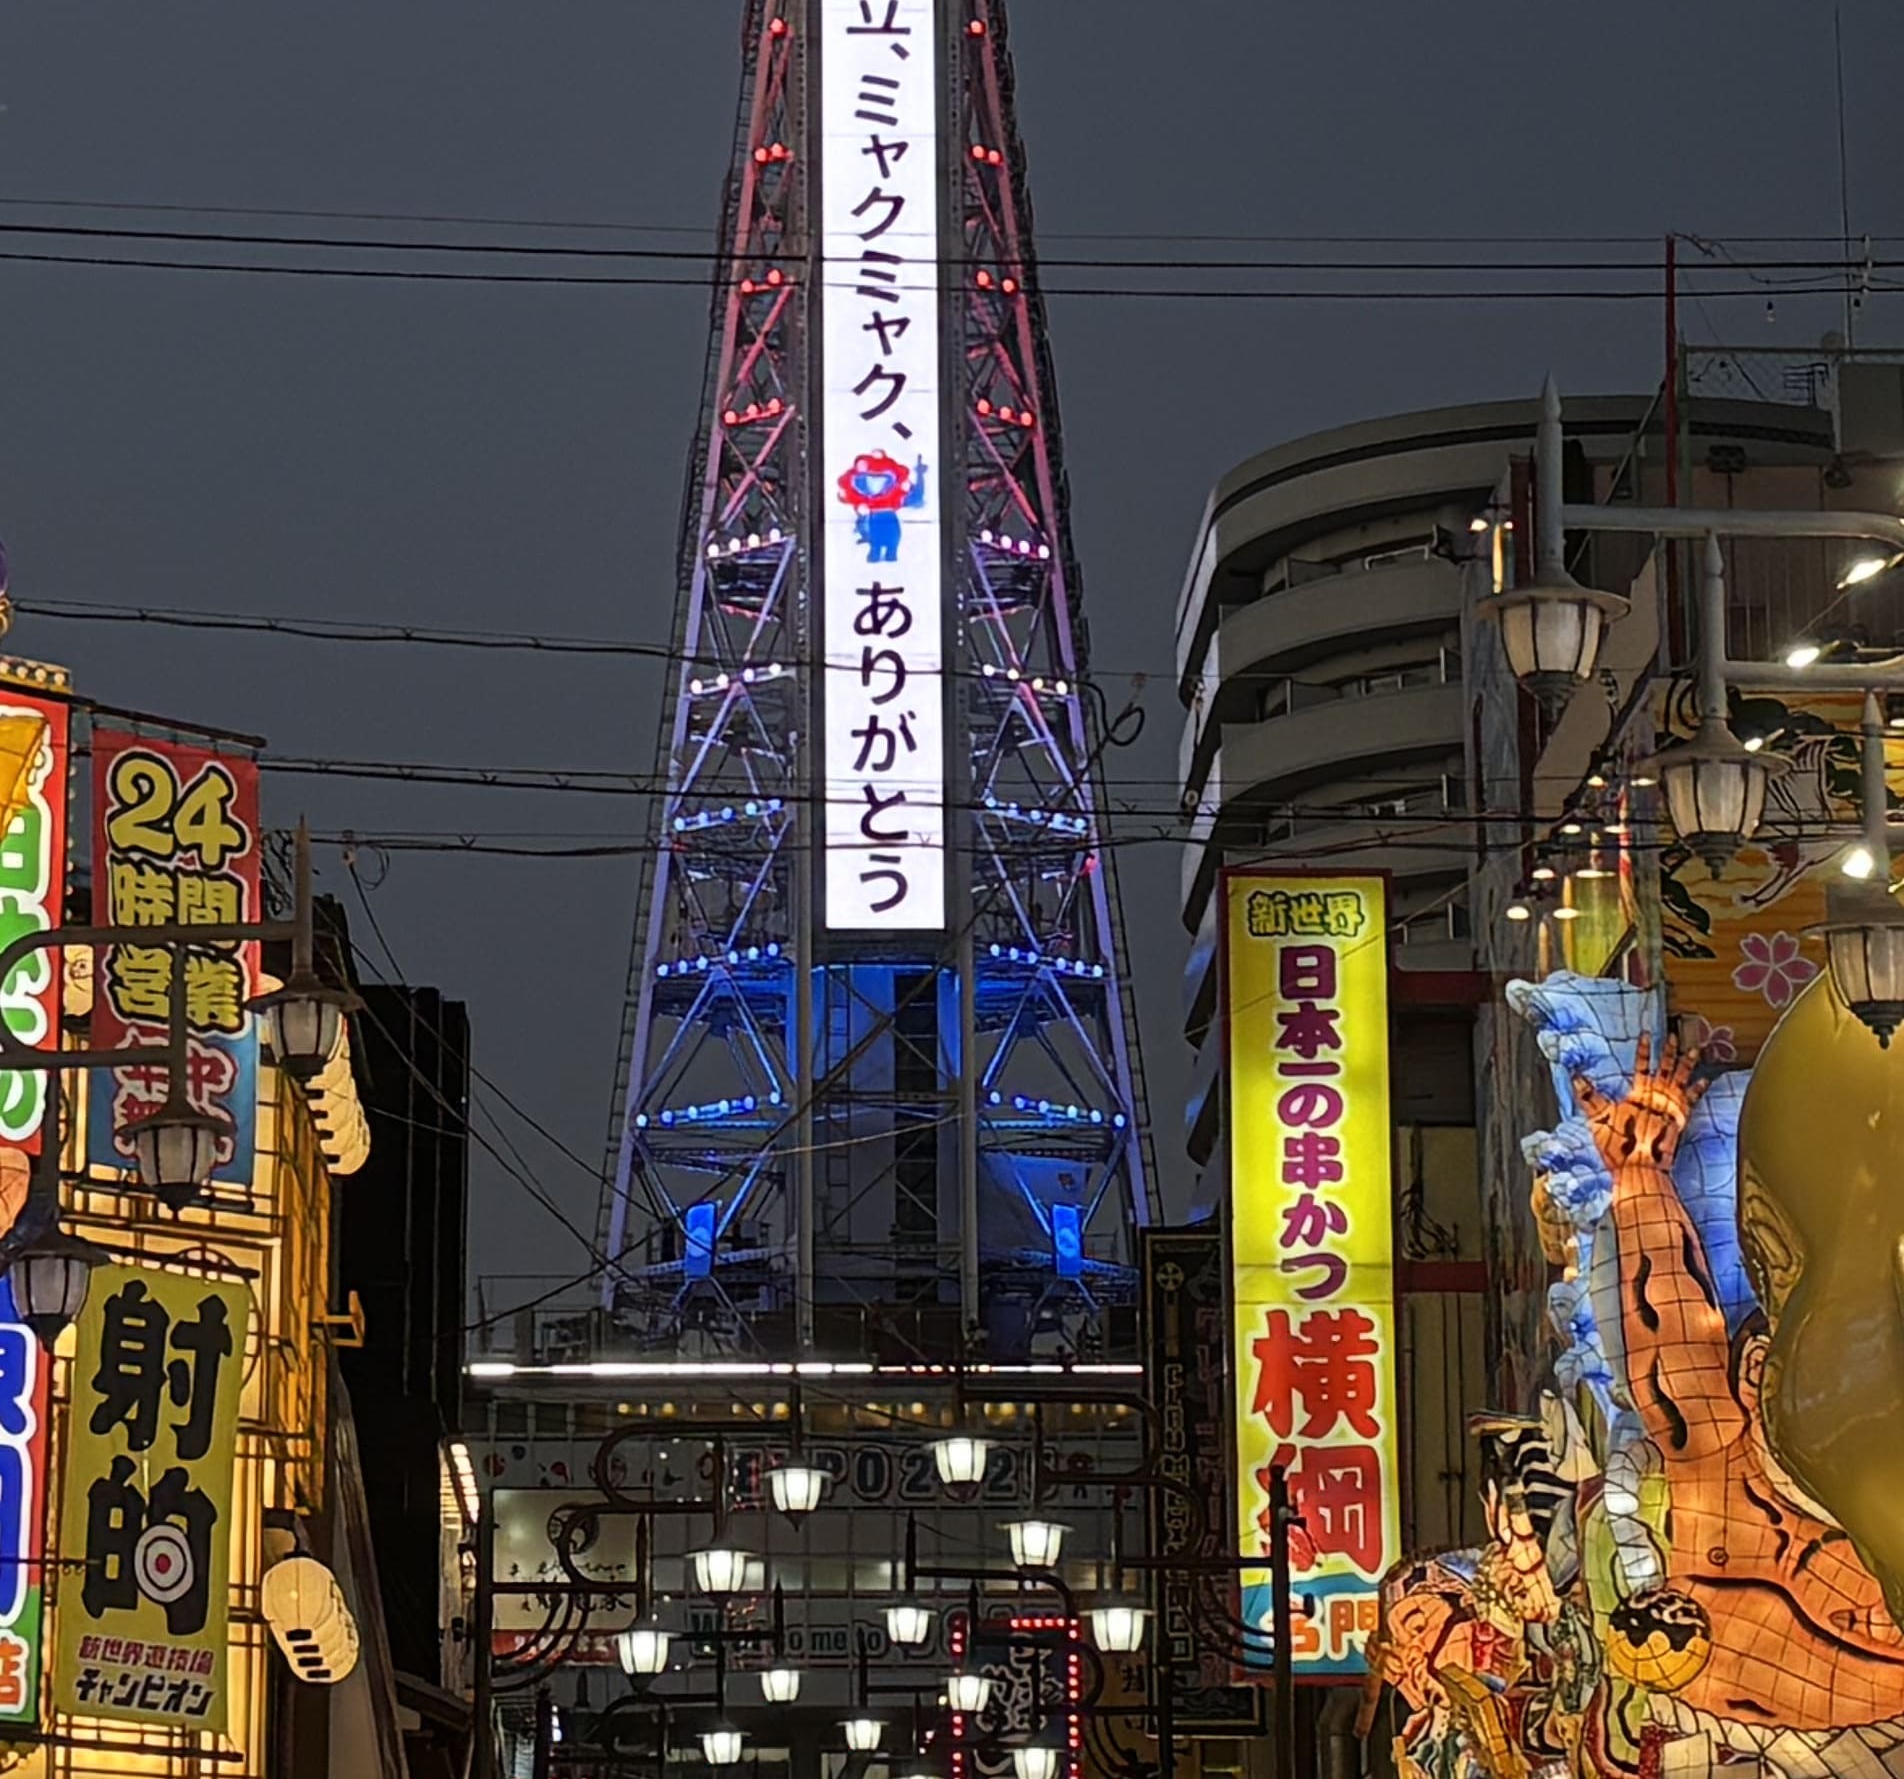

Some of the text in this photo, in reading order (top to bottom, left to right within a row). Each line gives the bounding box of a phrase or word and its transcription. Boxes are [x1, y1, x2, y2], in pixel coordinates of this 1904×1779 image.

[851, 580, 917, 914] ありがとう
[105, 751, 248, 869] 24
[108, 859, 243, 927] 時間
[1246, 888, 1366, 938] 新世界
[108, 946, 244, 1035] 営業
[1274, 943, 1348, 1302] 日本一の串かつ
[81, 1279, 233, 1635] 射的
[1251, 1307, 1386, 1576] 横綱
[75, 1667, 217, 1718] チャンピオン
